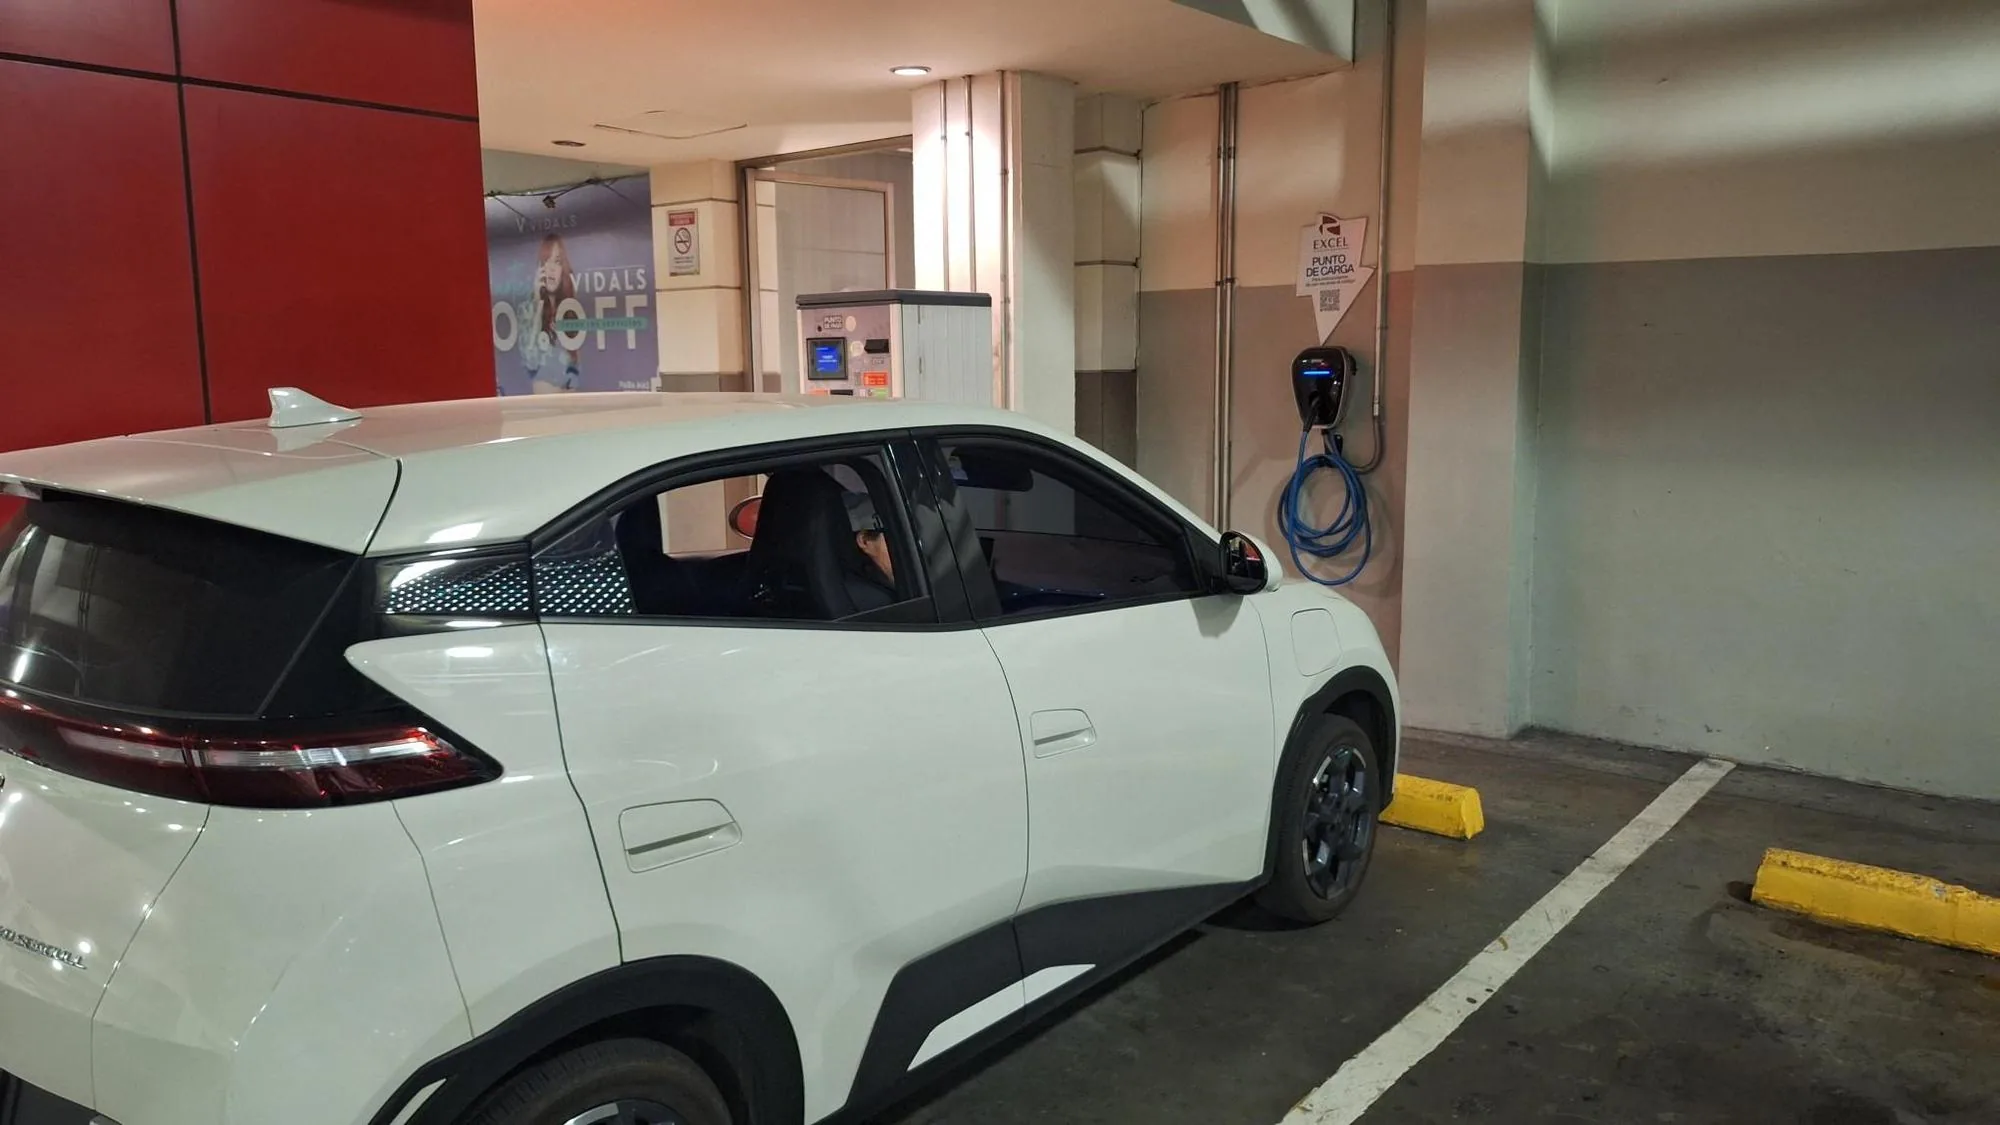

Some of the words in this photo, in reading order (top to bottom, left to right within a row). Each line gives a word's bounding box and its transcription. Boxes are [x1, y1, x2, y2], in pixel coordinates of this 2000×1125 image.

[530, 214, 578, 232] VIDALS
[1313, 236, 1348, 249] EXCEL
[1312, 254, 1346, 267] PUNTO
[1306, 267, 1319, 278] DE
[1320, 264, 1354, 276] CARGA
[570, 268, 648, 294] VIDALS
[555, 294, 649, 352] OFF
